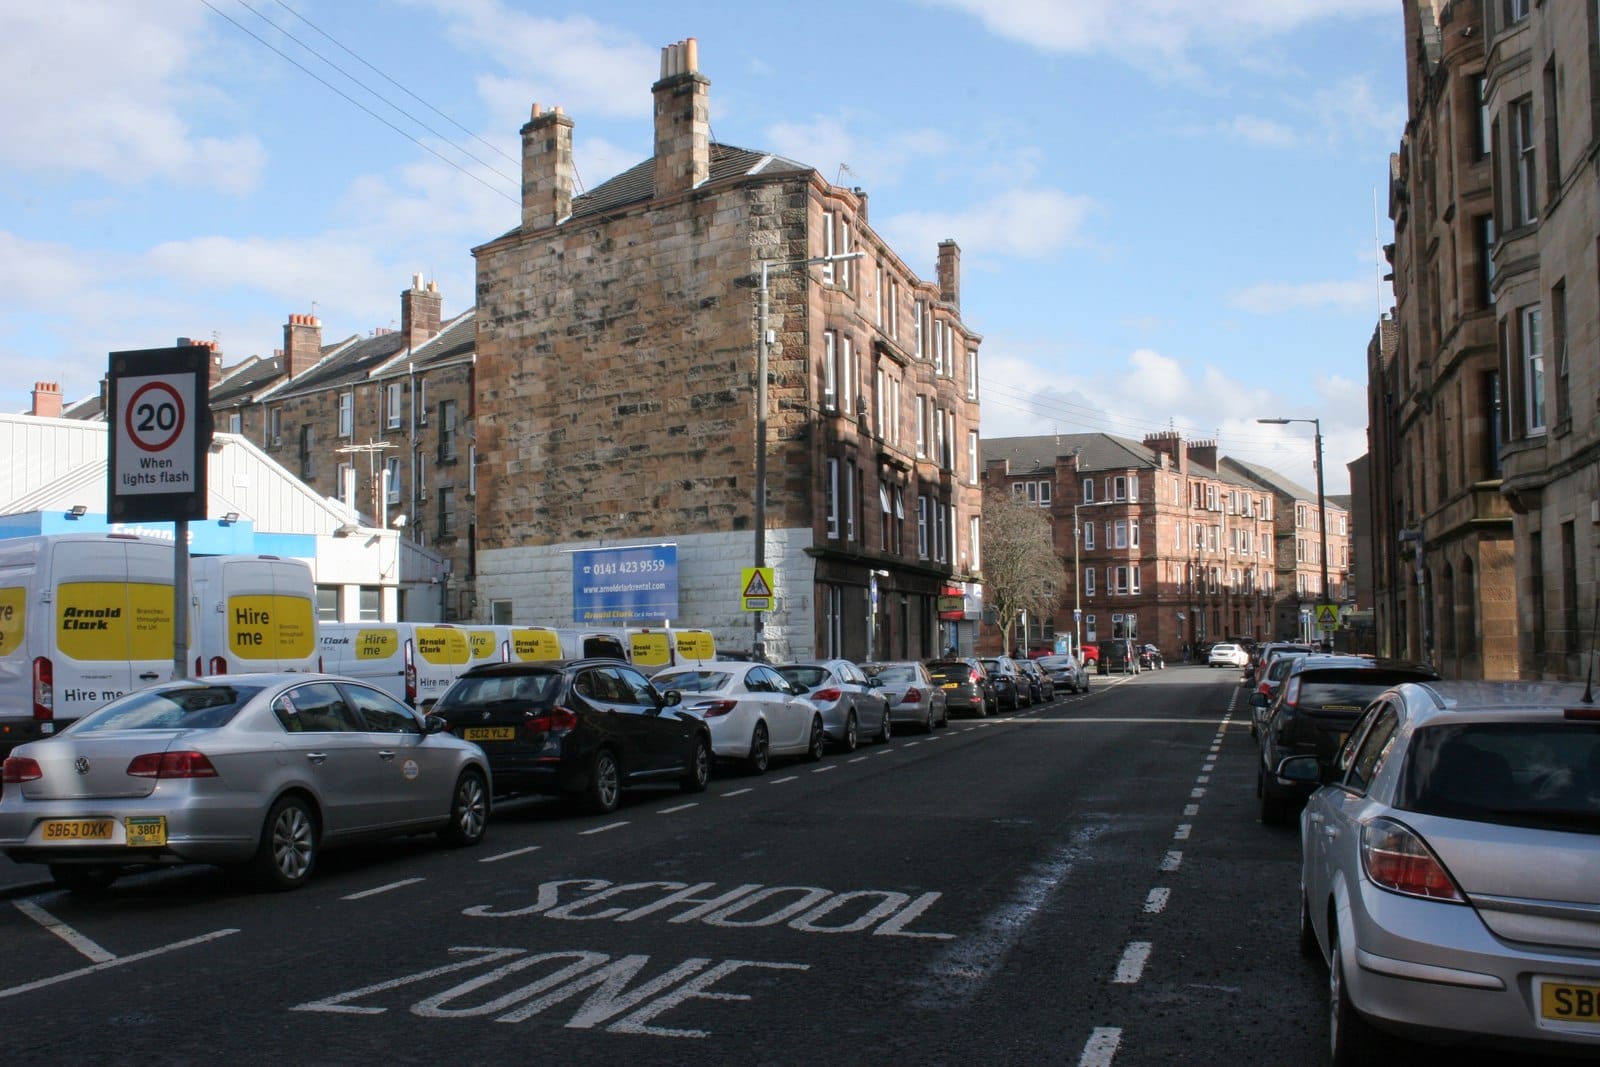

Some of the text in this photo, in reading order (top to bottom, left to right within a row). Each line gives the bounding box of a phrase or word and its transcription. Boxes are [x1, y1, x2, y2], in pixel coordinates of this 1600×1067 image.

[137, 403, 176, 431] 20
[140, 457, 172, 469] When
[123, 471, 189, 486] lights flash
[110, 524, 194, 544] Entrane
[593, 559, 665, 575] 0141 423 9559
[583, 582, 665, 594] www.arnoldclarkrental.com
[64, 607, 121, 618] Arnold
[236, 608, 269, 624] Hire
[612, 610, 633, 618] Clark
[63, 619, 108, 630] Clark
[237, 632, 262, 645] me
[323, 637, 350, 645] Clark
[364, 634, 388, 644] Hire
[419, 638, 446, 646] Arnold
[363, 646, 380, 655] me
[419, 677, 450, 687] Hire me
[65, 689, 124, 701] Hire me
[47, 823, 107, 837] SB63 OXK
[137, 824, 161, 836] 3807
[462, 879, 956, 940] SCHOOL
[289, 946, 811, 1039] ZONE
[1554, 988, 1600, 1018] SB
